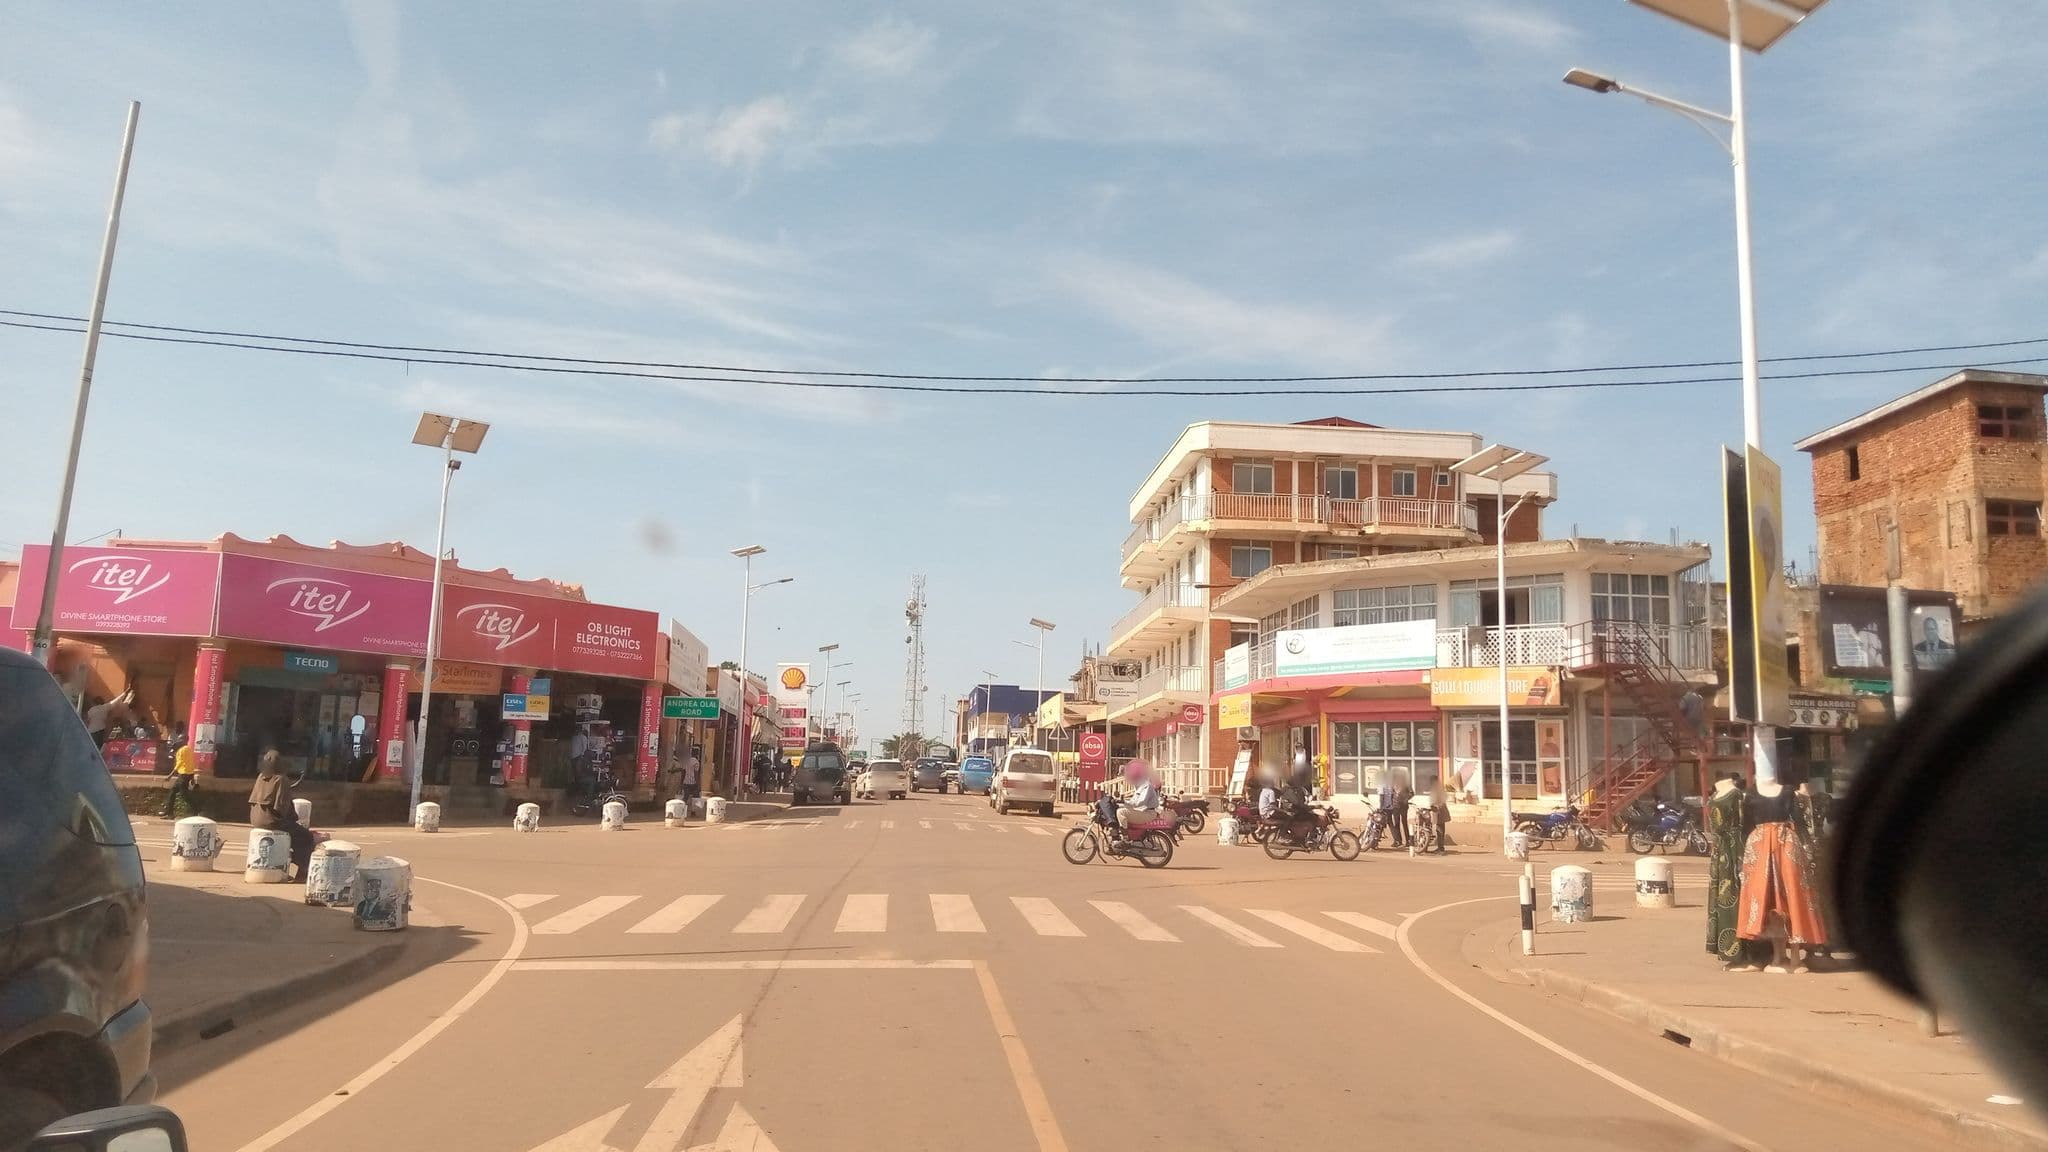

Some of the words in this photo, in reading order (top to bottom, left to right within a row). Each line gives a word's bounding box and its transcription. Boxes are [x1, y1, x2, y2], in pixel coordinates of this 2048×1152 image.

[91, 562, 152, 586] itel
[290, 584, 351, 612] itel
[60, 611, 88, 621] DIVINE
[88, 613, 143, 623] SMARTPHONE
[143, 615, 168, 624] STORE
[475, 609, 524, 634] itel
[587, 622, 602, 633] OB
[605, 624, 632, 637] LIGHT
[576, 633, 641, 650] ELECTRONICS
[295, 656, 329, 669] TECNO
[681, 708, 702, 716] ROAD
[1084, 741, 1101, 750] absa
